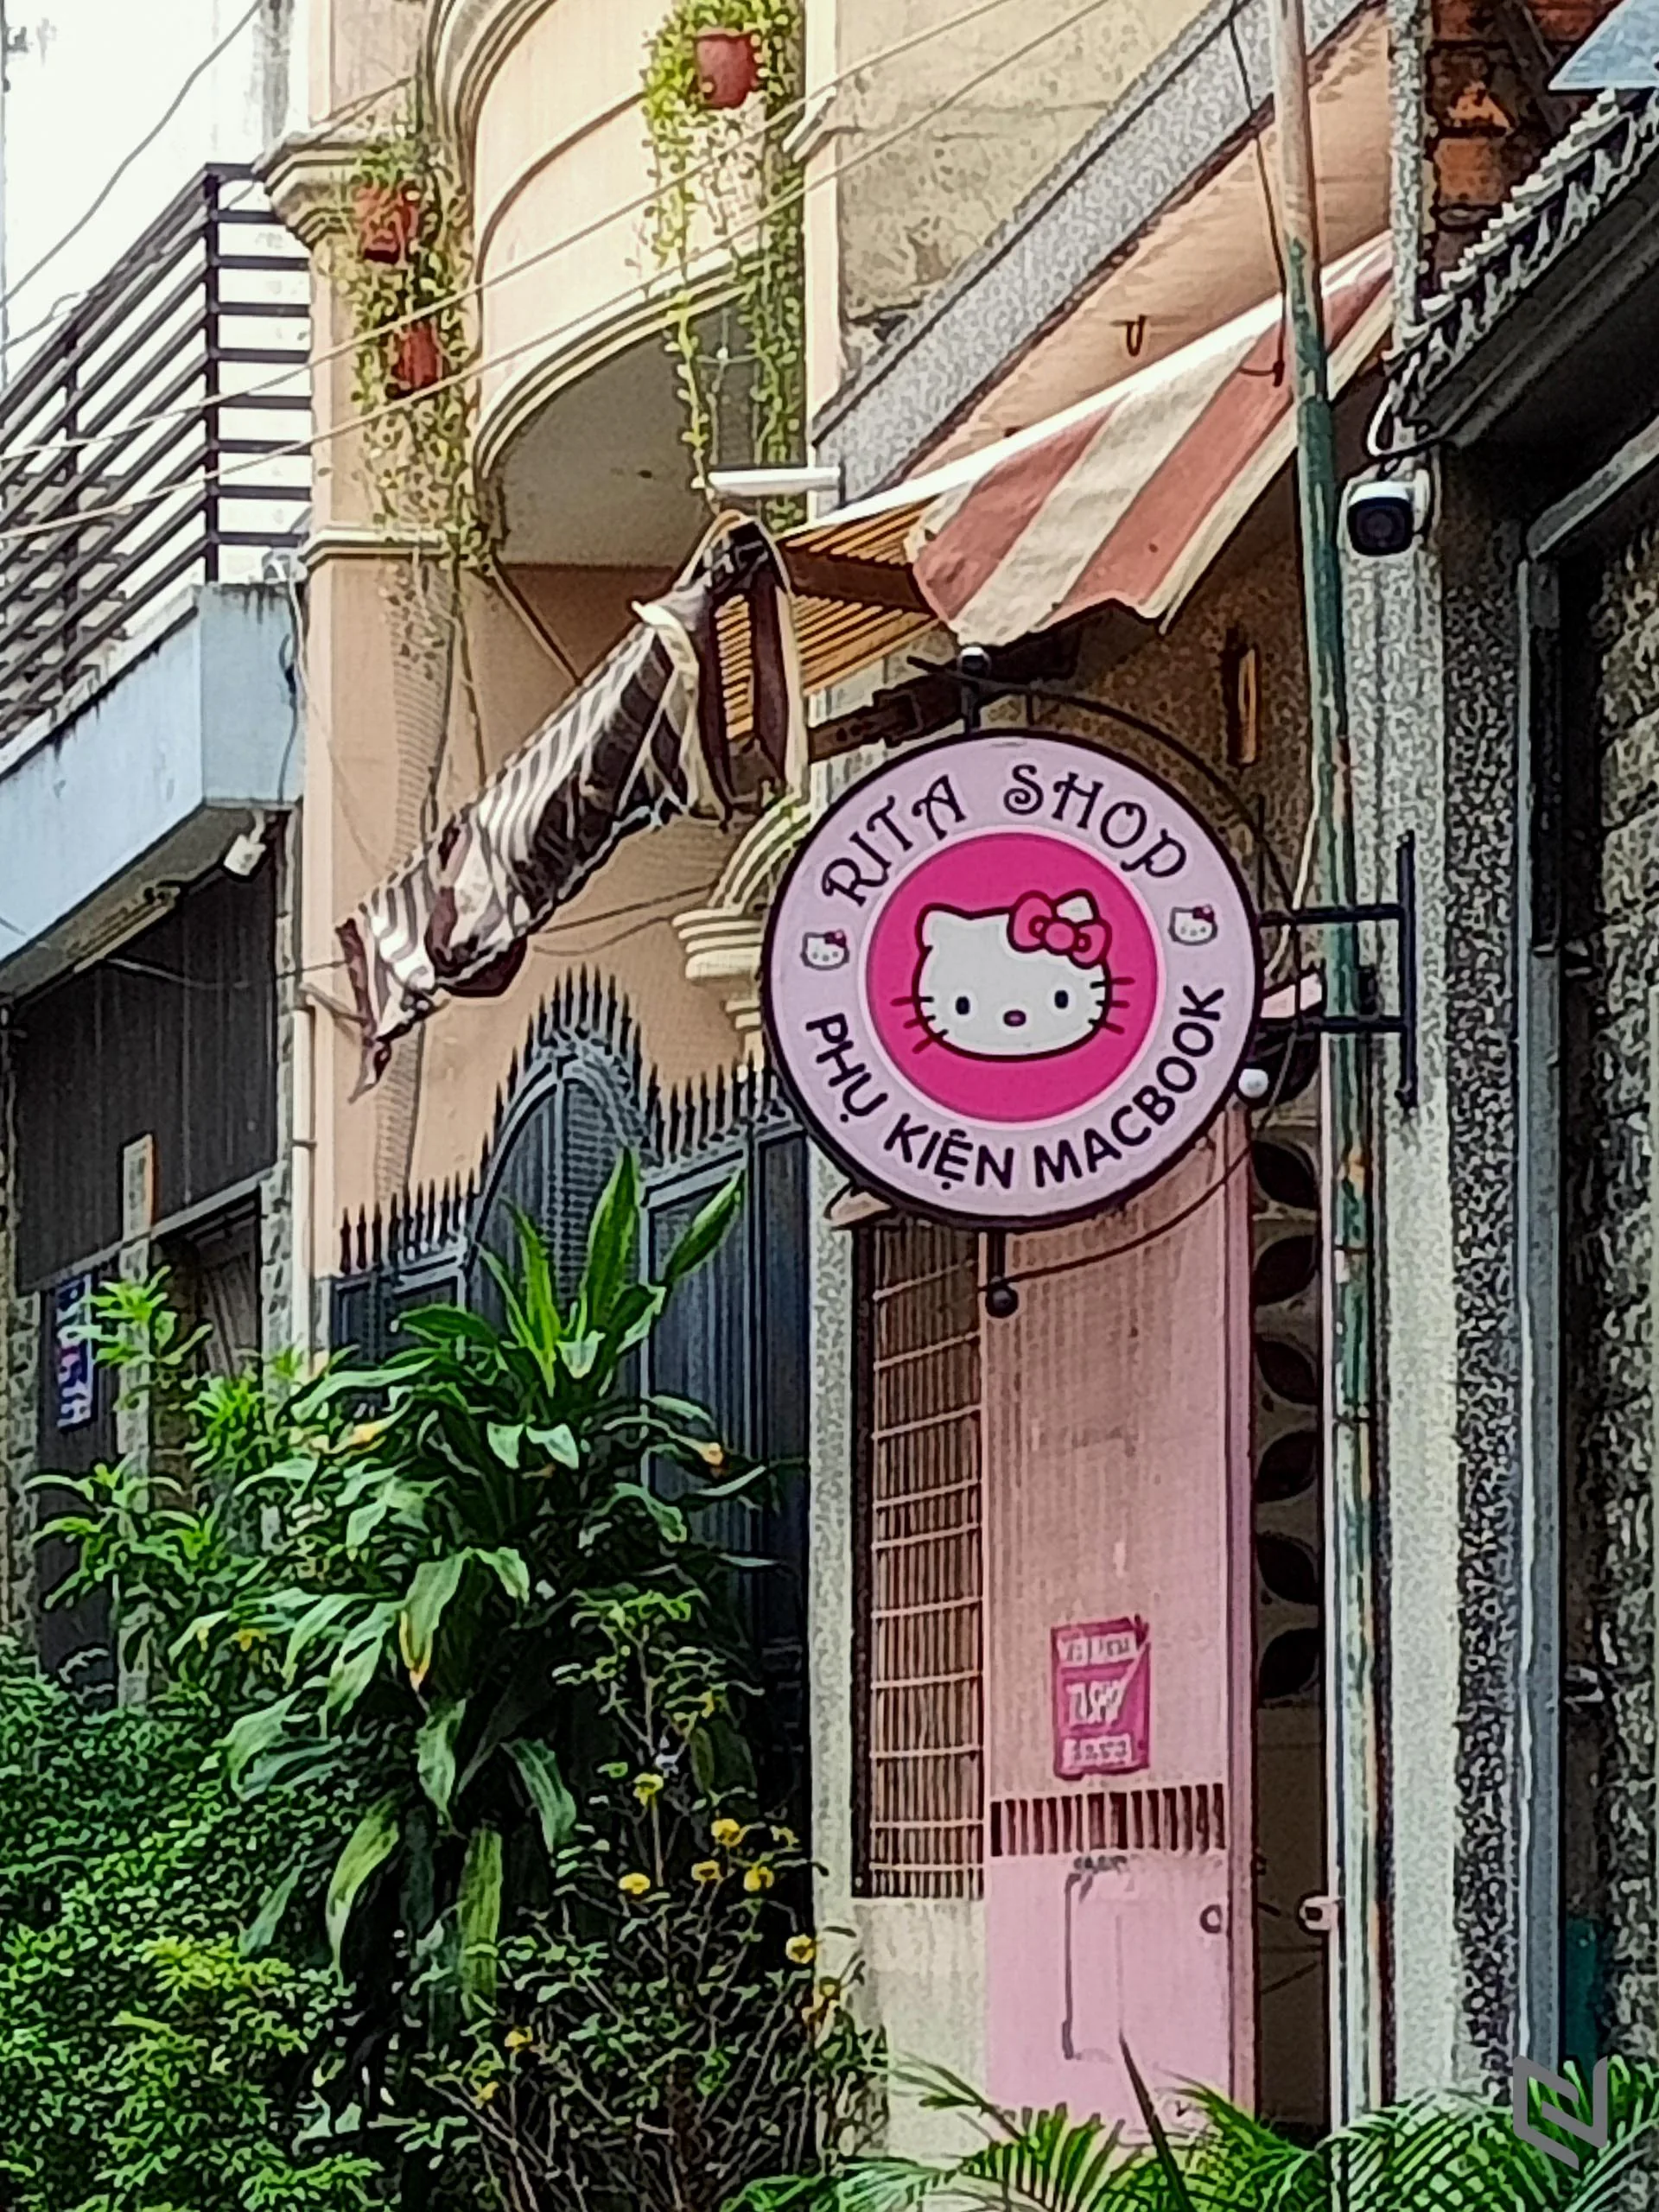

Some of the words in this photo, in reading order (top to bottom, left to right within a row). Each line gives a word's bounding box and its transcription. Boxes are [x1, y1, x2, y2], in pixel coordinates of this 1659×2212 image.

[822, 774, 967, 906] RITA
[1002, 764, 1187, 879] SHOP
[805, 1013, 888, 1123] PHỤ
[883, 1113, 1014, 1191] KIỆN
[1033, 983, 1225, 1187] MACBOOK
